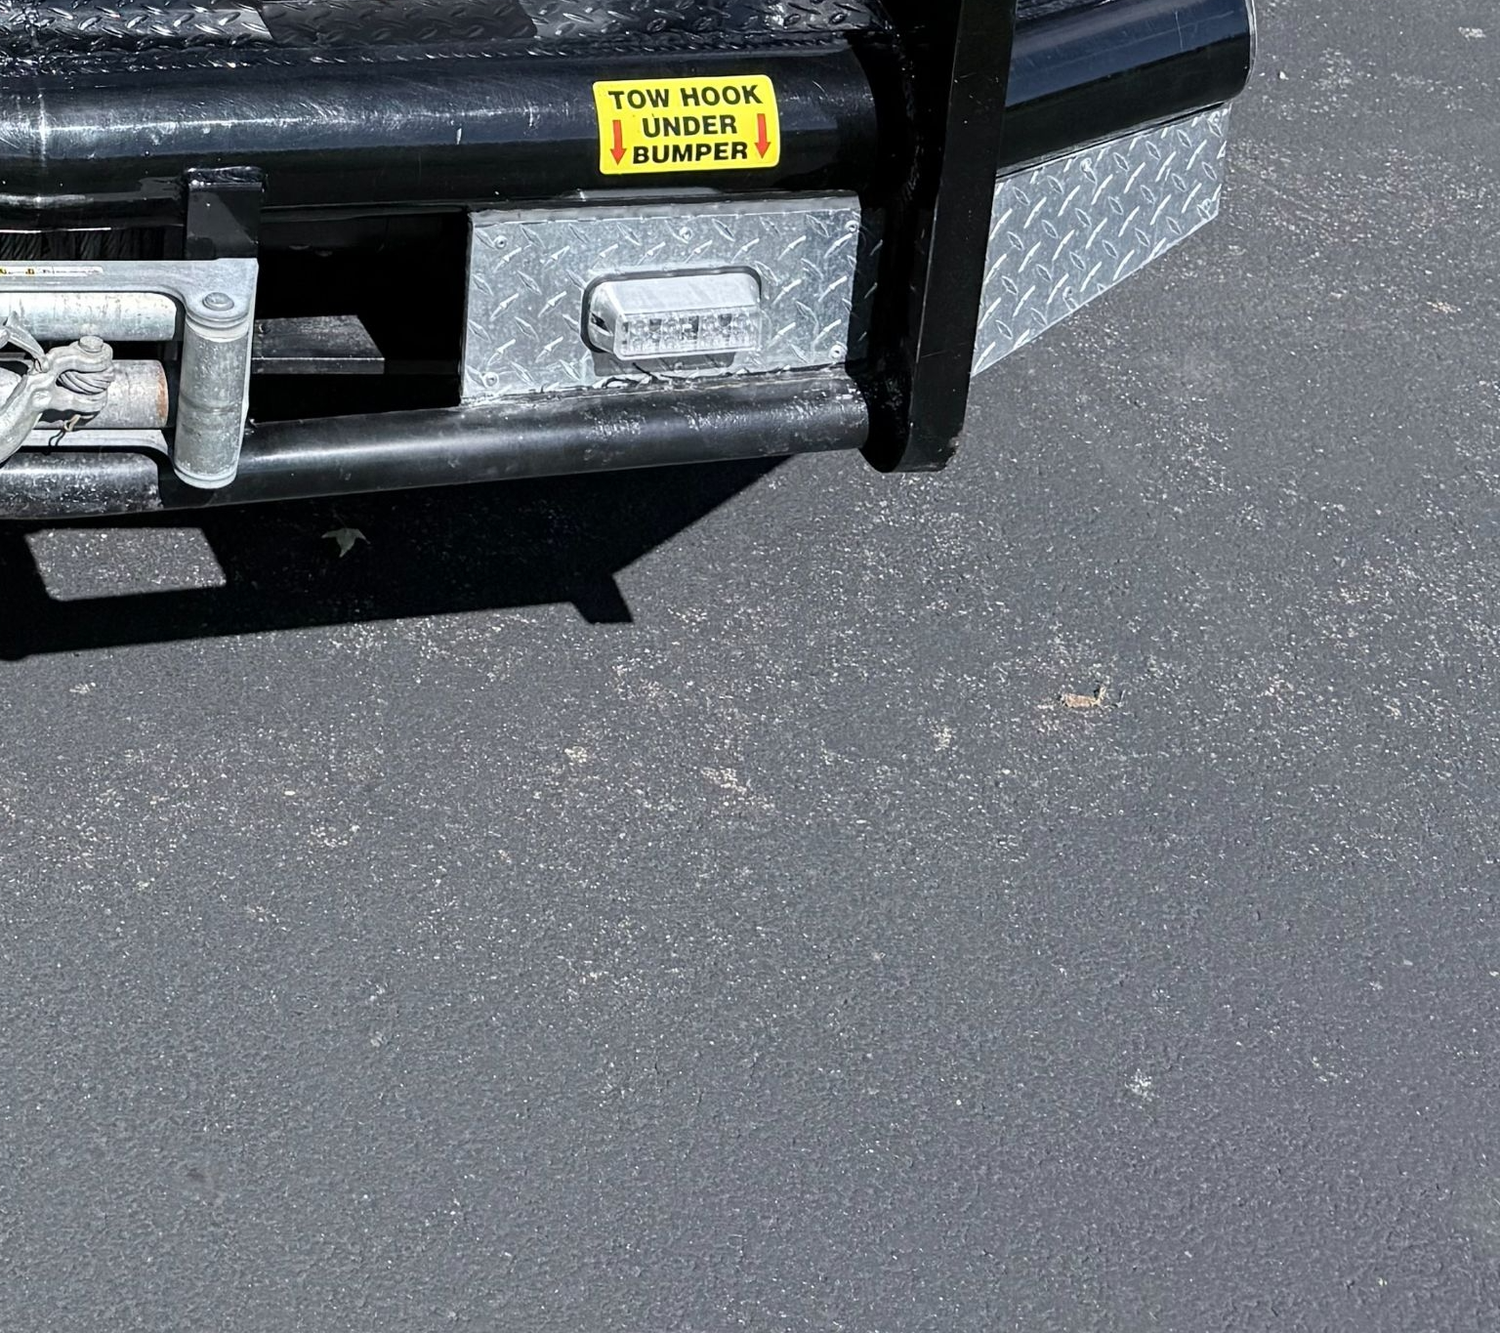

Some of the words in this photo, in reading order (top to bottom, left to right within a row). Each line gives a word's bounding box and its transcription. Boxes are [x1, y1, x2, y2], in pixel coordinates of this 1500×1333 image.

[607, 87, 670, 110] TOW
[680, 84, 764, 107] HOOK
[642, 114, 738, 138] UNDER
[632, 141, 748, 164] BUMPER
